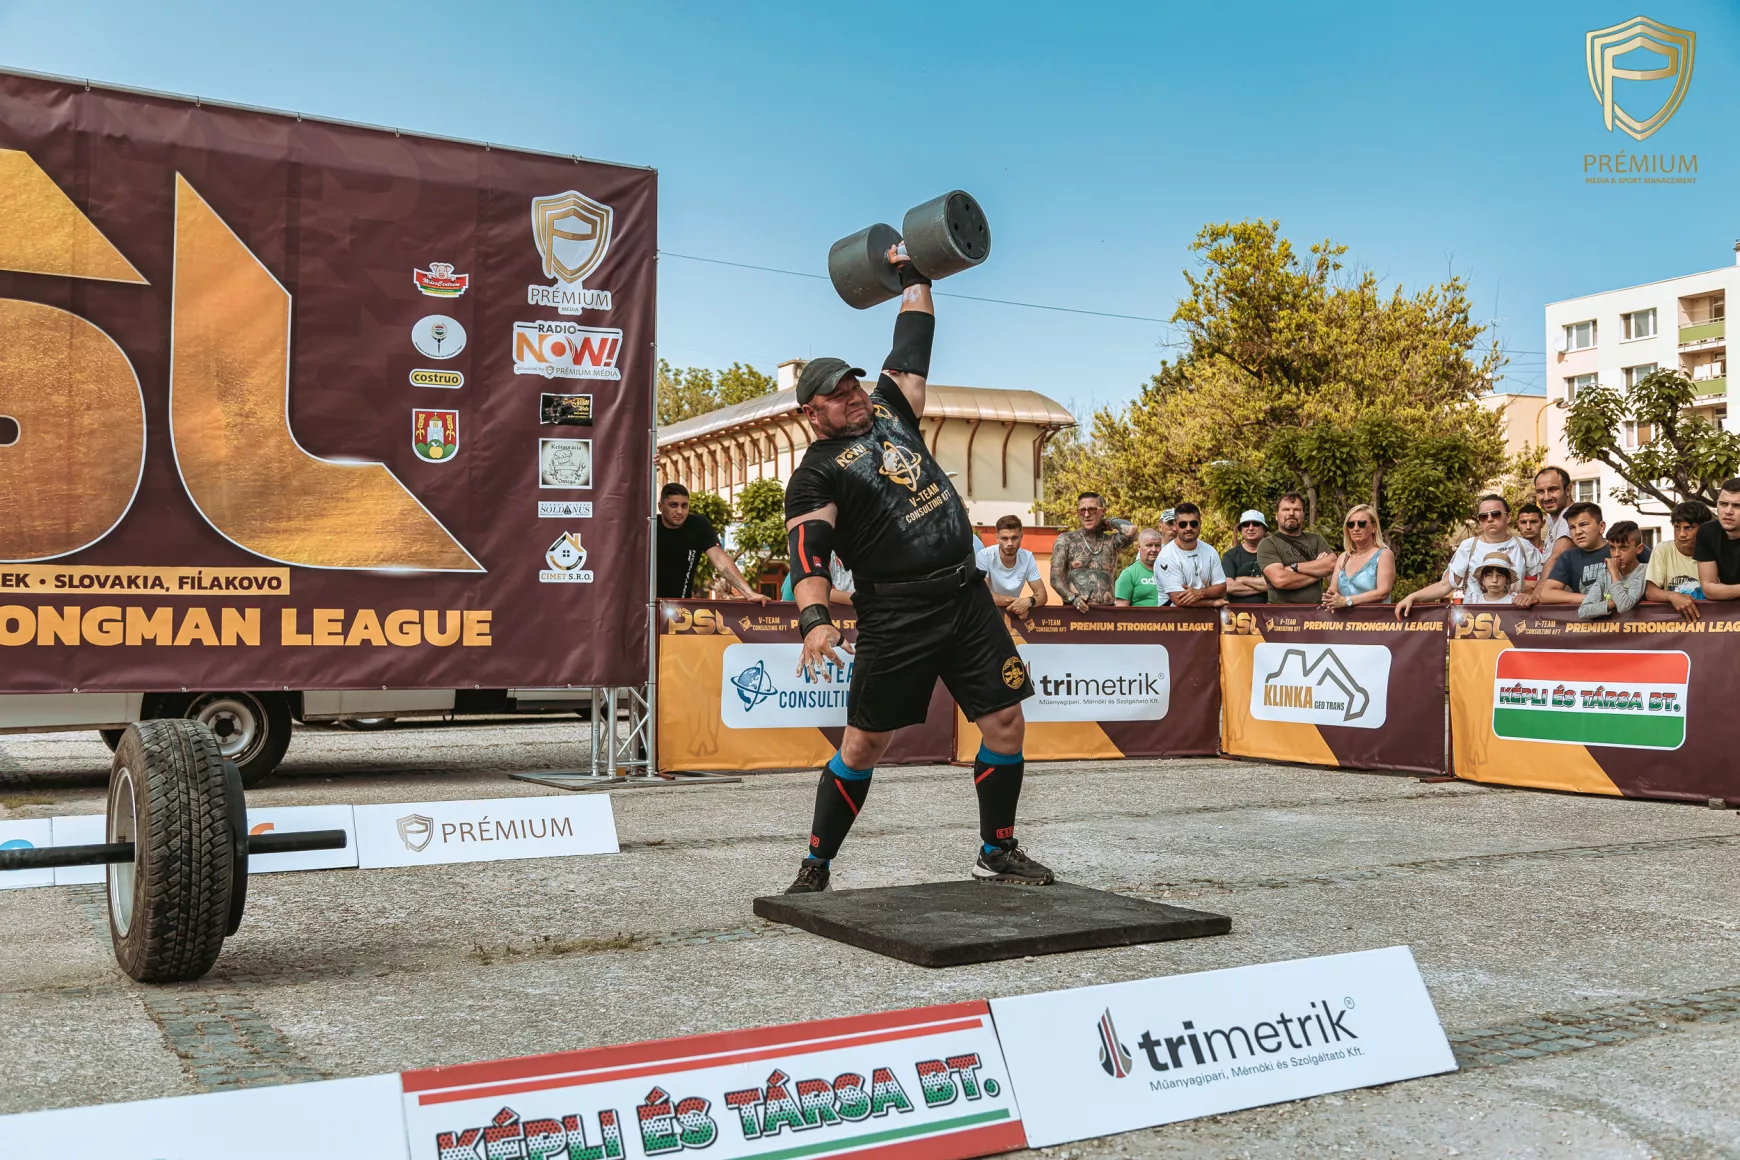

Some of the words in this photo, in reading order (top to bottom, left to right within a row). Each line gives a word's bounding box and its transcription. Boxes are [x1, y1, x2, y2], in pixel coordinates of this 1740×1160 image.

[531, 287, 609, 307] PRÉMIUM
[538, 323, 577, 334] RADIO
[516, 332, 620, 367] NOW!
[414, 374, 459, 384] costruo
[556, 367, 591, 376] PRÉMIUM
[593, 369, 618, 377] MÉDIA
[909, 483, 940, 507] V-TEAM
[905, 496, 943, 523] CONSULTING
[54, 573, 171, 592] SLOVAKIA,
[568, 573, 591, 581] S.R.O.
[281, 609, 493, 647] LEAGUE
[668, 608, 734, 635] PSL
[1070, 621, 1115, 631] PREMIUM
[1117, 622, 1175, 632] STRONGMAN
[1177, 622, 1214, 632] LEAGUE
[1303, 621, 1344, 631] PREMIUM
[1345, 621, 1403, 631] STRONGMAN
[1404, 621, 1443, 632] LEAGUE
[1454, 612, 1509, 639] PSL
[1534, 620, 1556, 628] V-TEAM
[1565, 622, 1620, 633] PREMIUM
[1623, 621, 1706, 633] STRONGMAN
[1263, 684, 1313, 709] KLINKA
[1314, 700, 1325, 709] GEO
[1326, 701, 1345, 711] TRANS
[1500, 682, 1548, 706] KÉPLI
[1552, 684, 1576, 707] ÉS
[1581, 685, 1644, 710] TÁRSA
[1649, 692, 1681, 712] BT.
[441, 816, 573, 843] PRÉMIUM
[1149, 1069, 1229, 1092] Műanyagipari,
[1231, 1063, 1274, 1078] Mérnöki
[1276, 1060, 1289, 1070] és
[1290, 1050, 1345, 1067] Szolgáltató
[1347, 1047, 1365, 1057] Kft.
[436, 1106, 626, 1160] KÉPLI
[636, 1086, 718, 1156] ÉS
[725, 1069, 914, 1140] TÁRSA
[916, 1053, 1000, 1108] BT.
